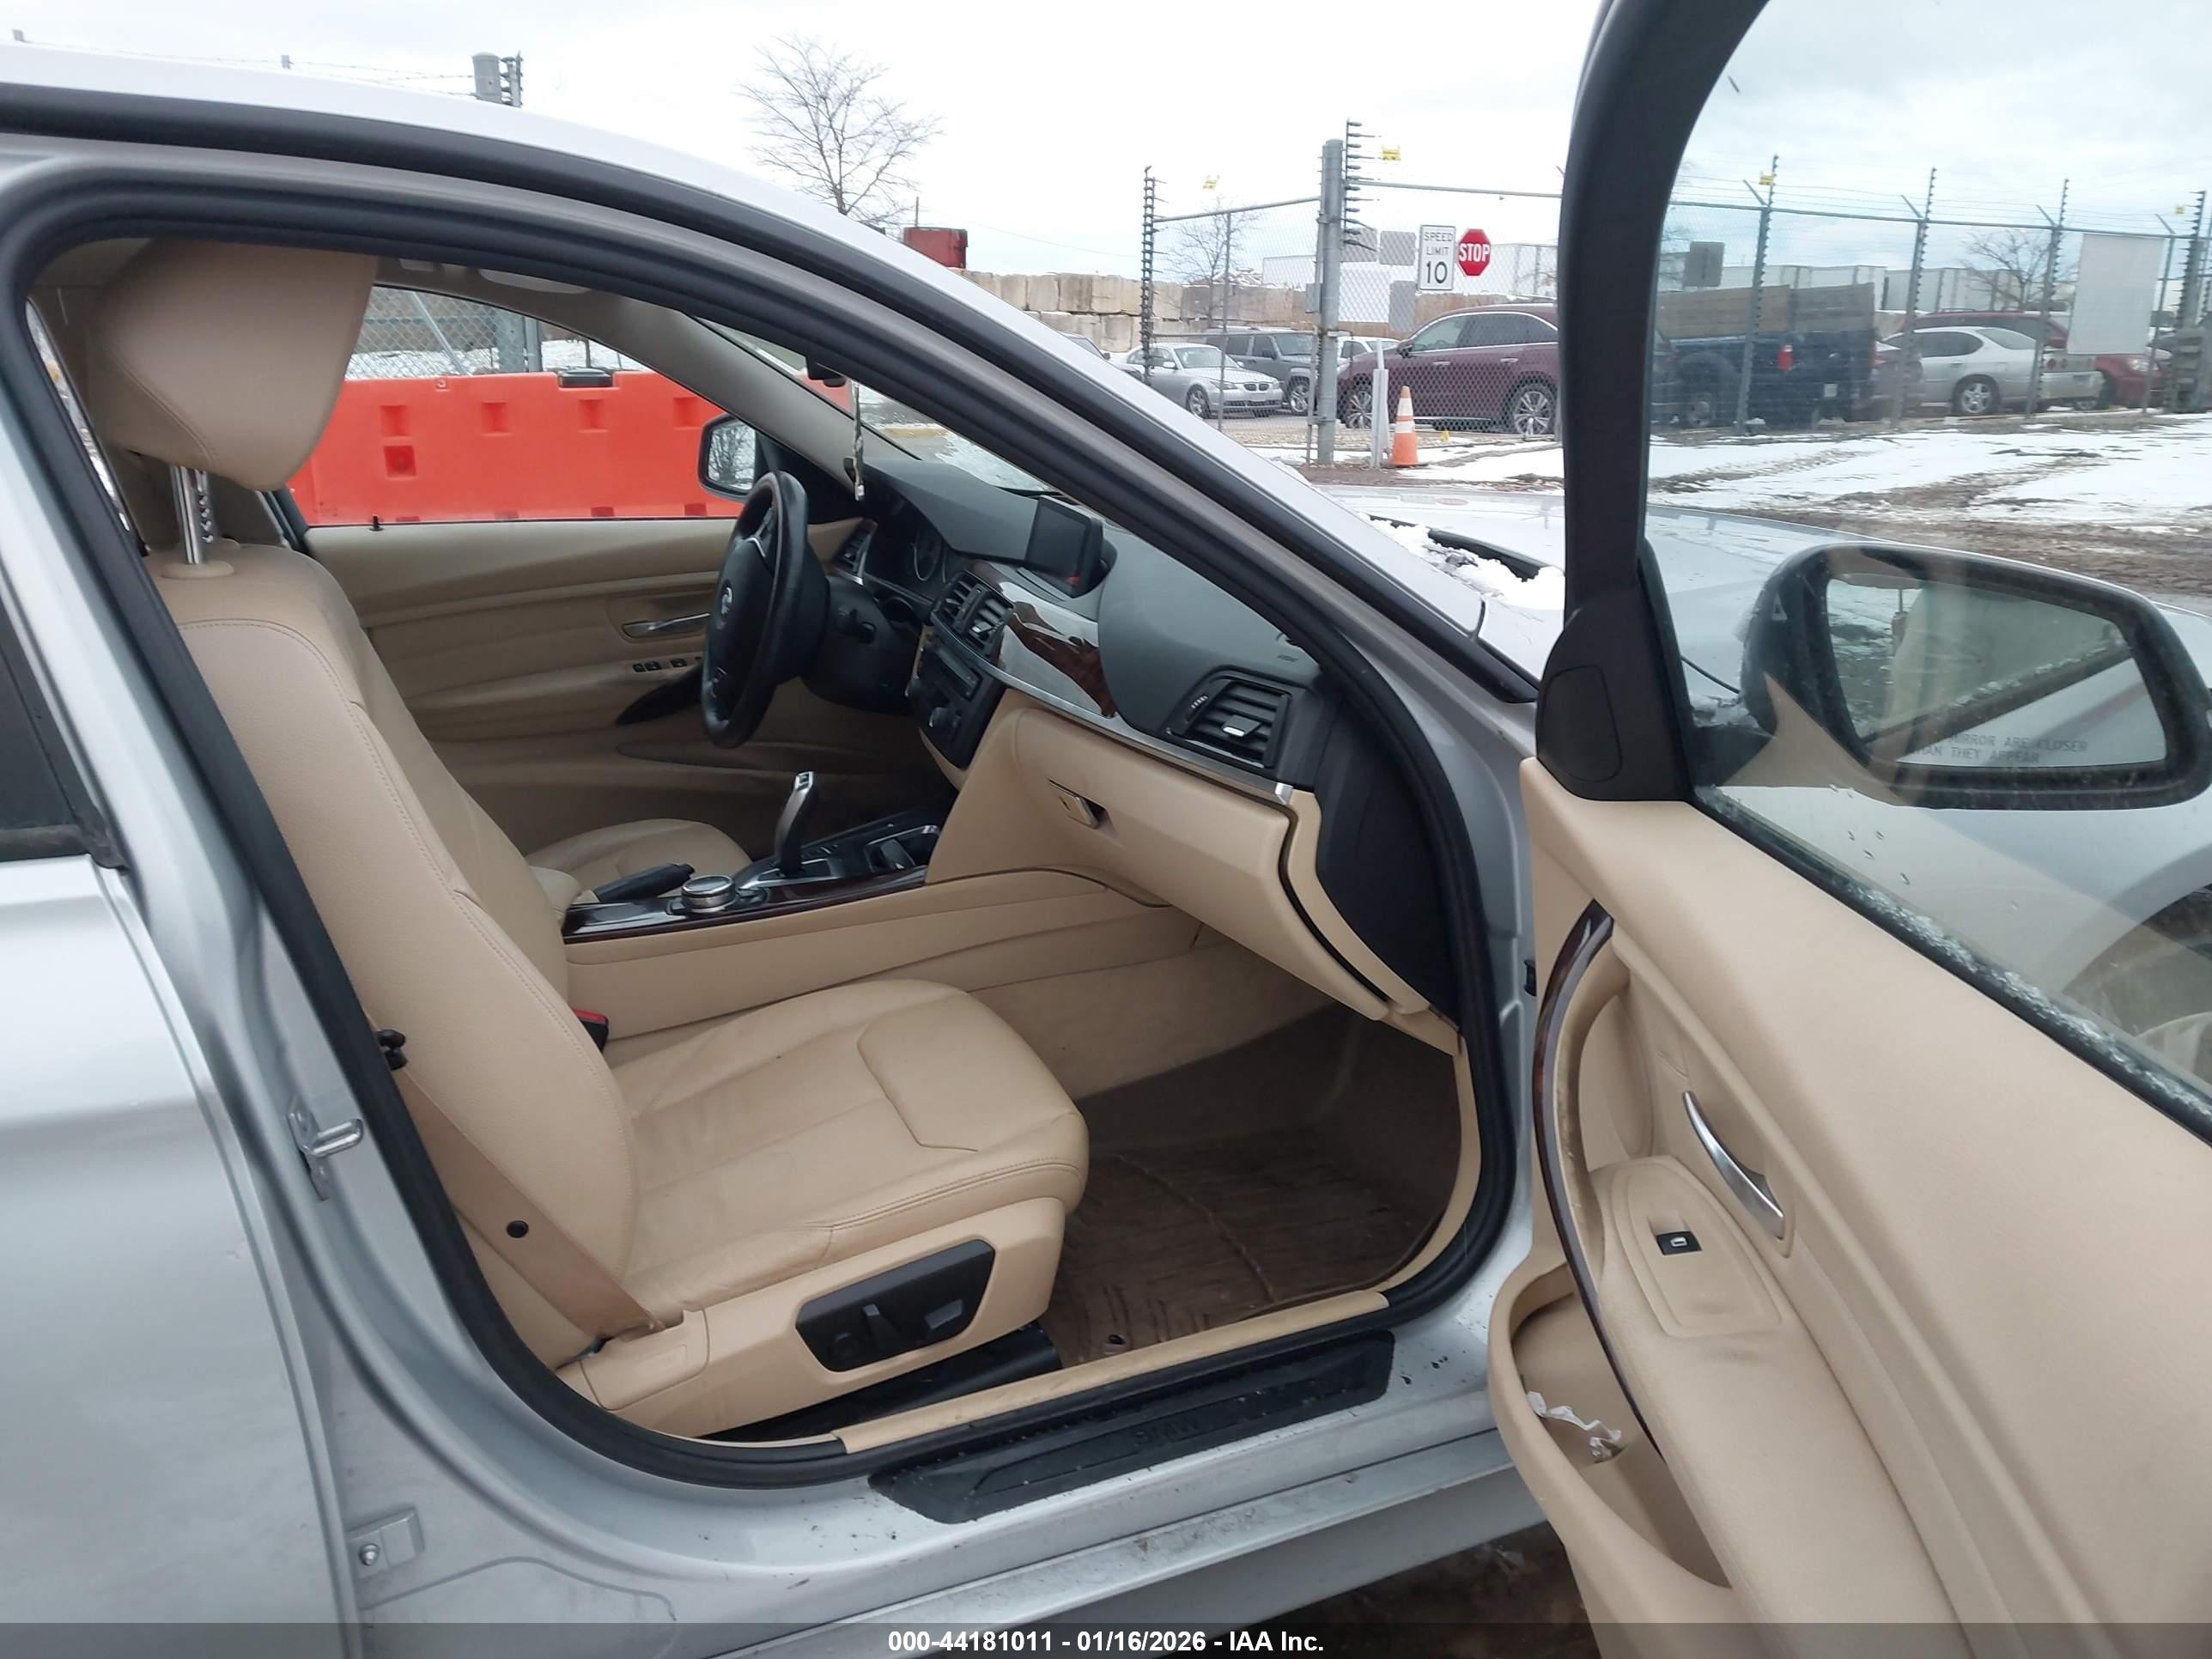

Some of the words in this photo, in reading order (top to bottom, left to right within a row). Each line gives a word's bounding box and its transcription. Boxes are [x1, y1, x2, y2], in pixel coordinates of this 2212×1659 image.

[1423, 231, 1454, 242] SPEED
[1425, 246, 1450, 256] LIMIT
[1459, 243, 1491, 262] STOP
[1426, 260, 1448, 284] 10
[1950, 745, 1980, 760] THEY
